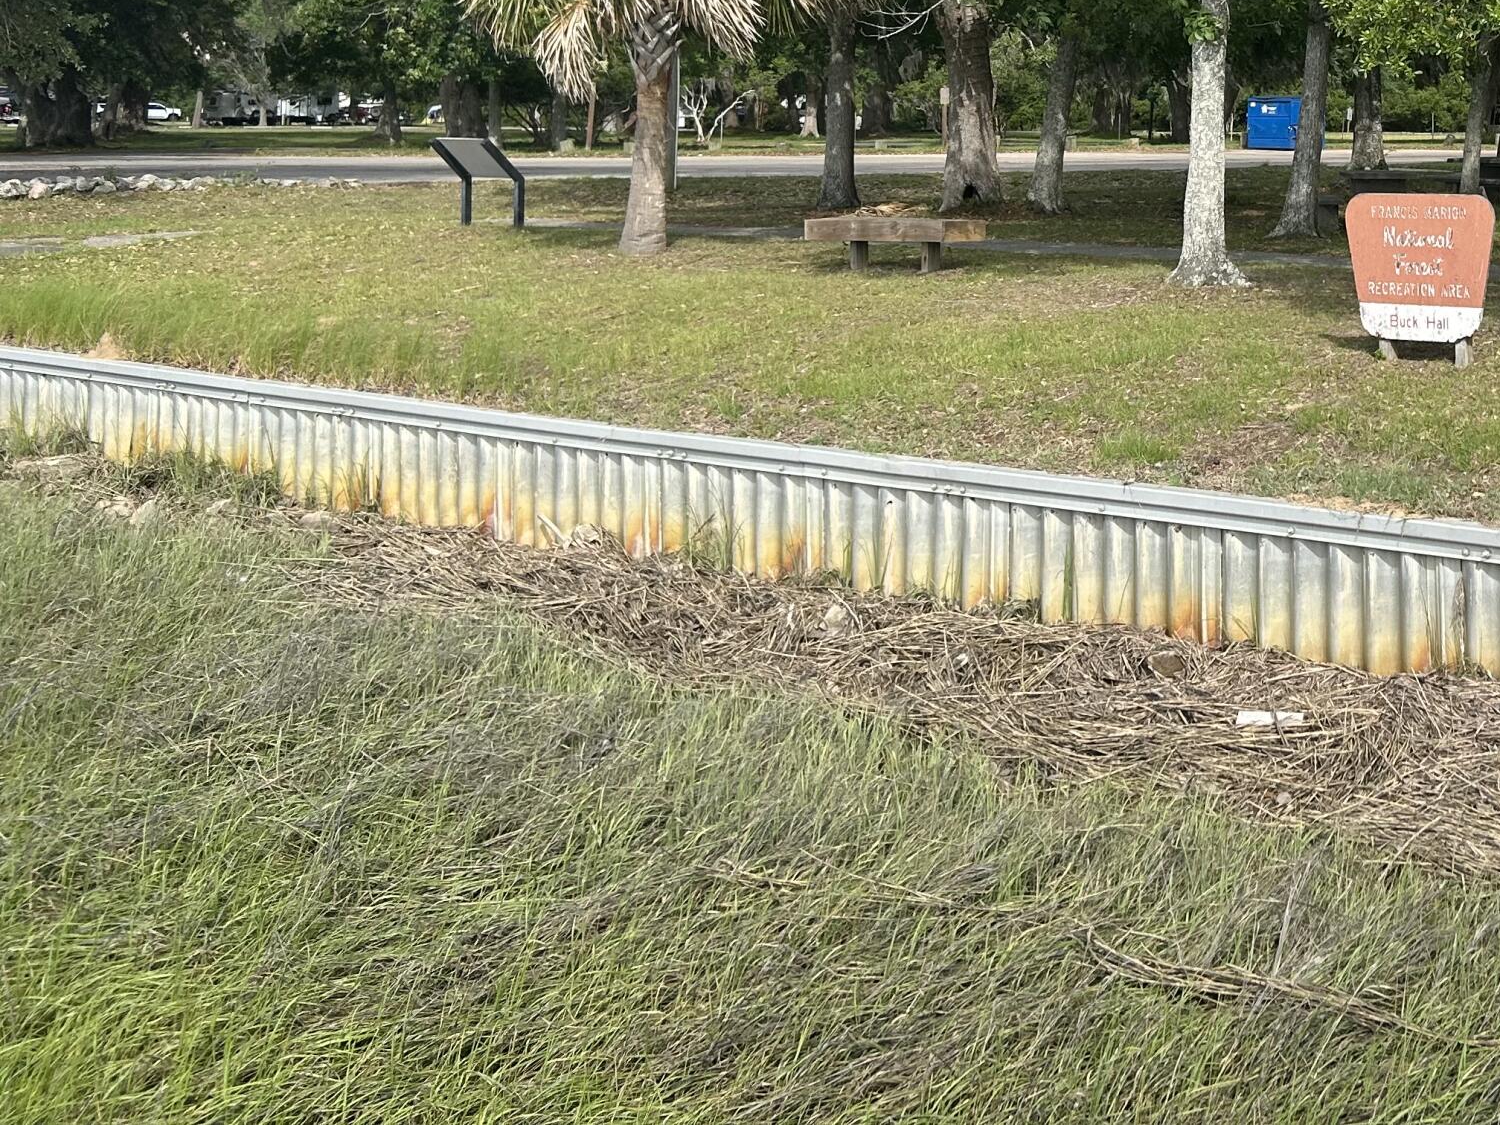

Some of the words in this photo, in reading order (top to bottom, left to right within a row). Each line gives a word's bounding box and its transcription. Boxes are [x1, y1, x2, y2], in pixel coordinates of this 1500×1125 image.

[1370, 205, 1418, 220] FRANCIS
[1423, 206, 1467, 220] MARION
[1383, 226, 1455, 249] National
[1368, 281, 1435, 297] RECREATION
[1440, 283, 1471, 299] AREA
[1390, 314, 1418, 329] Buck
[1426, 315, 1450, 330] Hall
